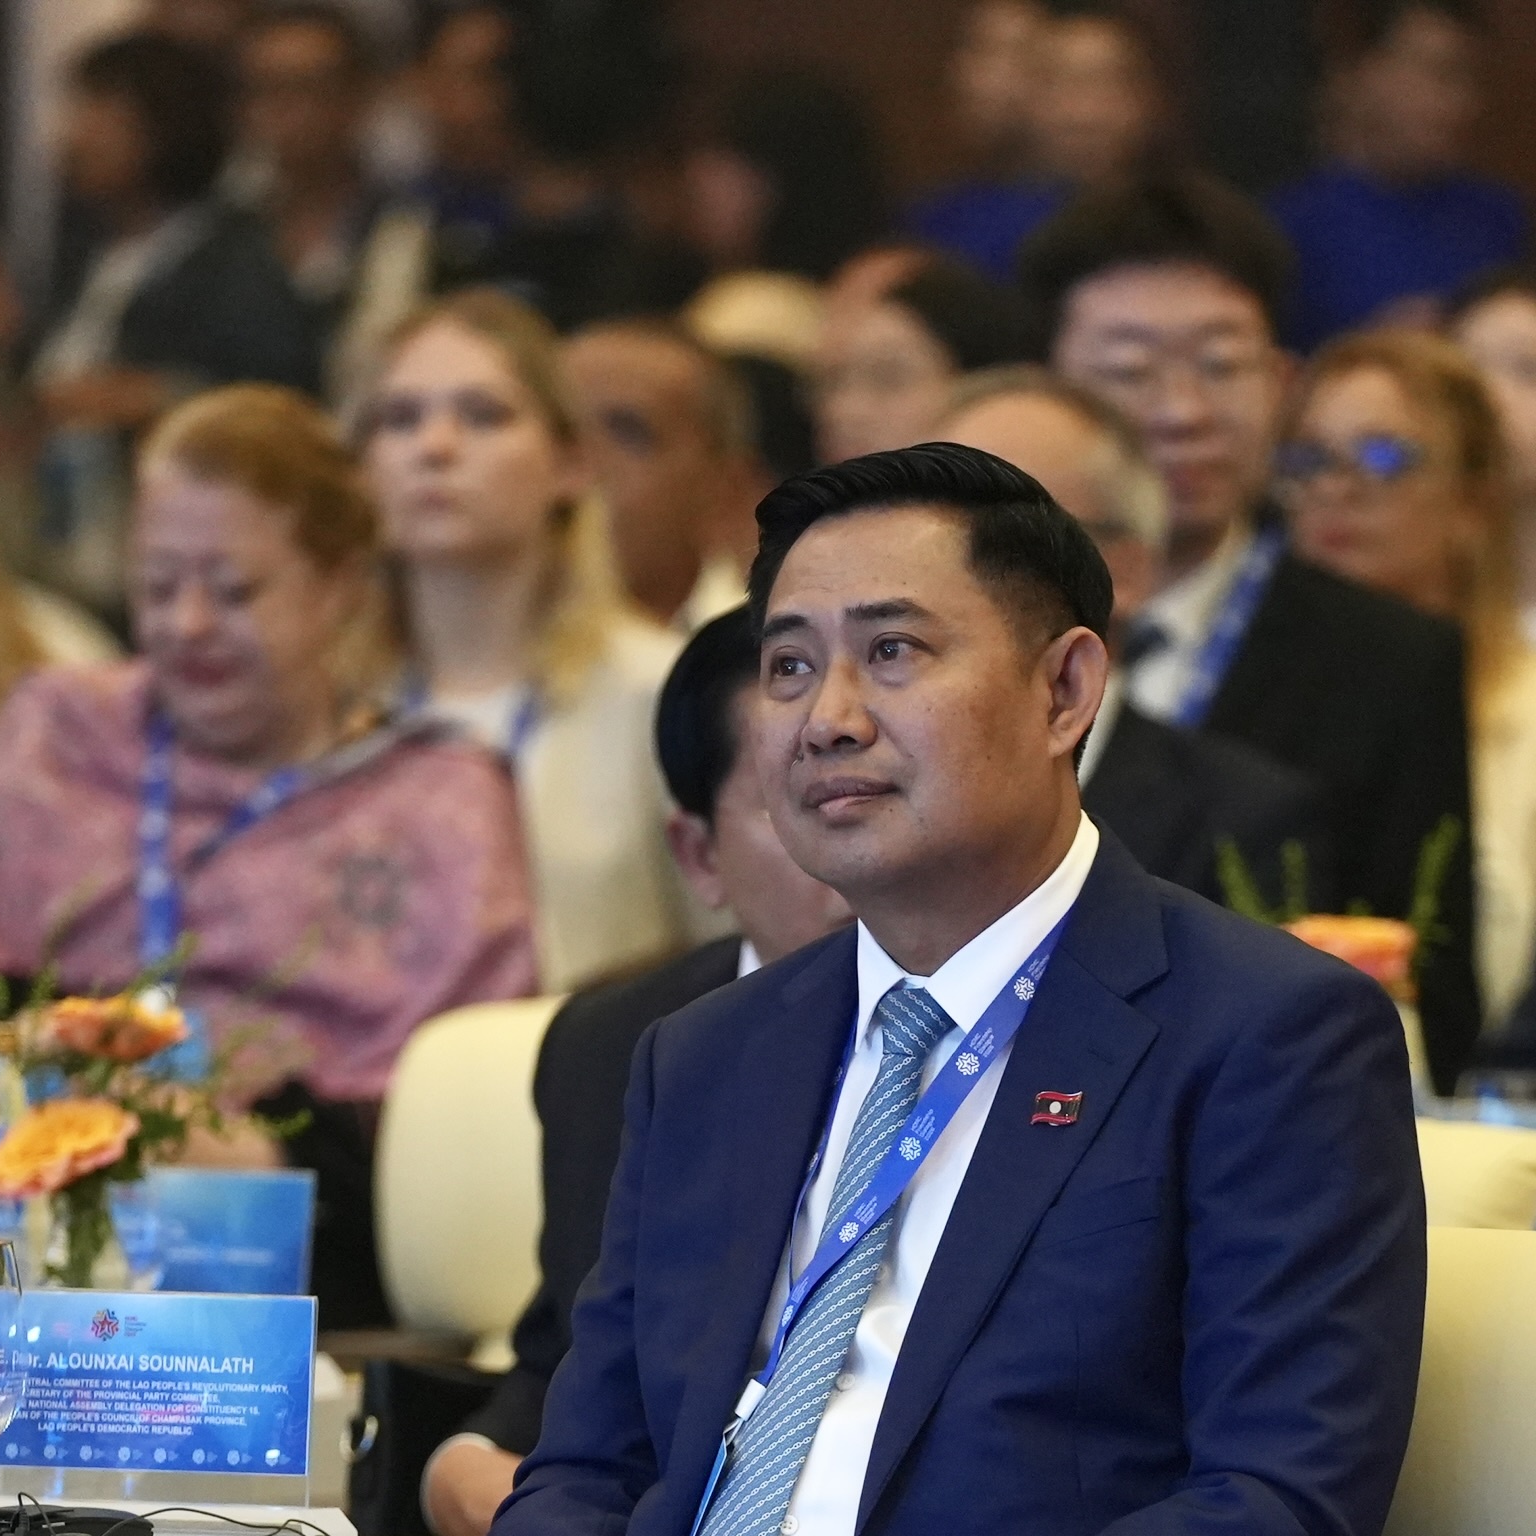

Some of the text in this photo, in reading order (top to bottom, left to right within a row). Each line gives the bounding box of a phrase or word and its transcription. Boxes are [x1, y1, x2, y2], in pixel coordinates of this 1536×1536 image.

[46, 1351, 134, 1371] ALOUNXAI
[138, 1354, 254, 1374] SOUNNALATH
[53, 1378, 100, 1389] COMMITTEE
[101, 1380, 113, 1389] OF
[115, 1380, 131, 1391] THE
[132, 1380, 150, 1391] LAO
[192, 1382, 259, 1394] REVOLUTIONARY
[62, 1389, 74, 1399] OF
[76, 1389, 92, 1400] THE
[93, 1390, 142, 1401] PROVINCIAL
[143, 1391, 170, 1402] PARTY
[28, 1400, 68, 1410] NATIONAL
[69, 1400, 112, 1412] ASSEMBLY
[114, 1402, 165, 1413] DELEGATION
[167, 1403, 184, 1413] FOR
[185, 1404, 247, 1415] CONSTITUENCY
[30, 1410, 41, 1420] OF
[43, 1411, 59, 1421] THE
[139, 1413, 151, 1424] OF
[152, 1414, 202, 1426] CHAMPASAK
[37, 1421, 55, 1432] LAO
[97, 1424, 150, 1435] DEMOCRATIC
